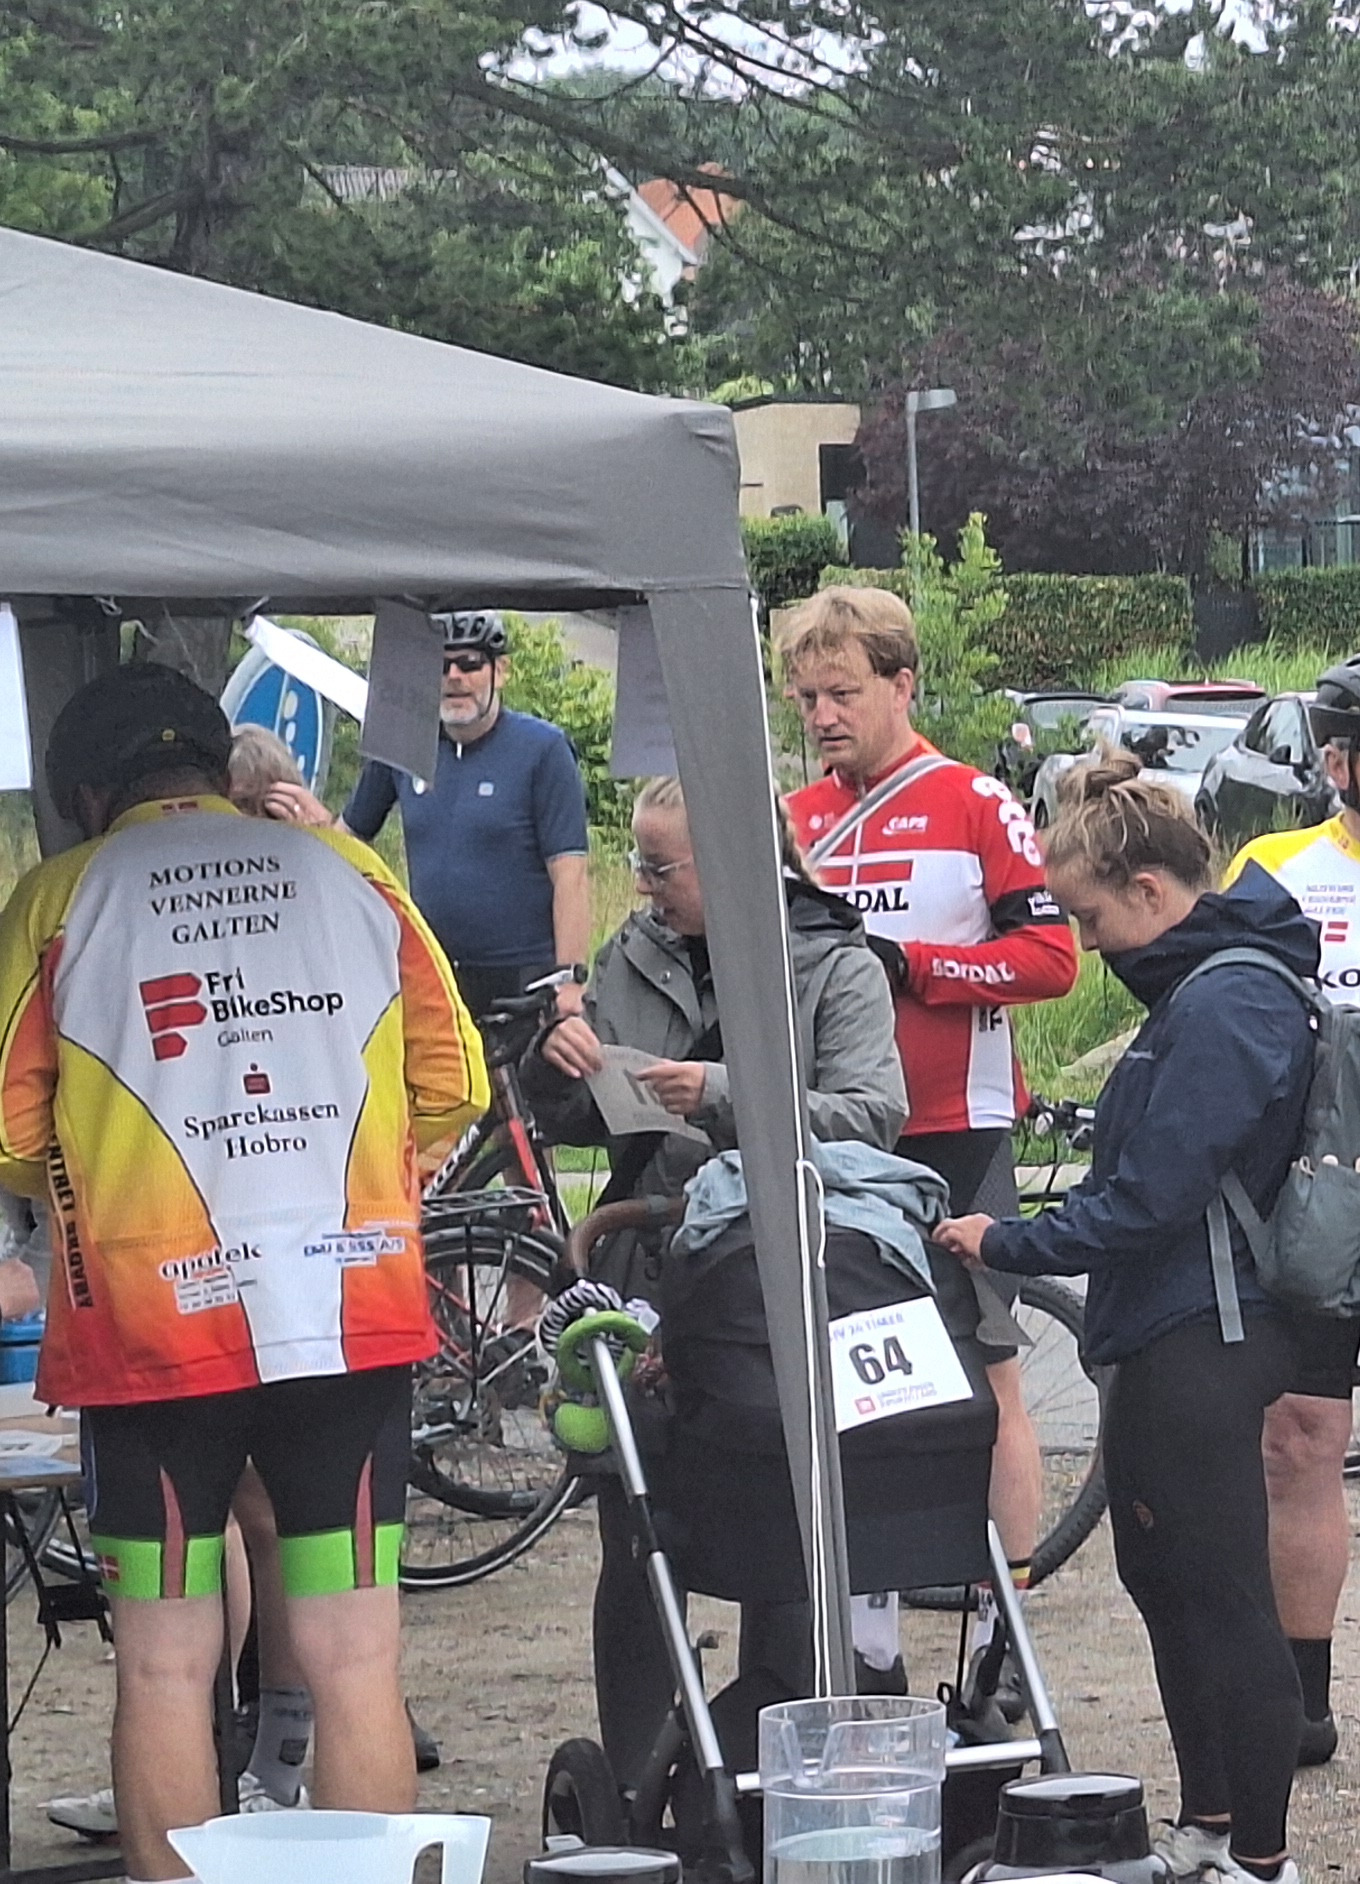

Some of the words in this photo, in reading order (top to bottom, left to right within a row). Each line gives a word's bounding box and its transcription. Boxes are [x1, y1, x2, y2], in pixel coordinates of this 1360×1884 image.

[149, 855, 281, 889] MOTIONS
[151, 880, 298, 917] VENNERNE
[848, 887, 910, 914] DAL
[171, 911, 281, 945] GALTEN
[205, 967, 245, 996] Fri
[211, 990, 344, 1023] BikeShop
[217, 1028, 274, 1048] Galten
[183, 1102, 340, 1141] Sparekassen
[225, 1134, 308, 1160] Hobro
[161, 1241, 263, 1280] apotek
[849, 1335, 913, 1385] 64
